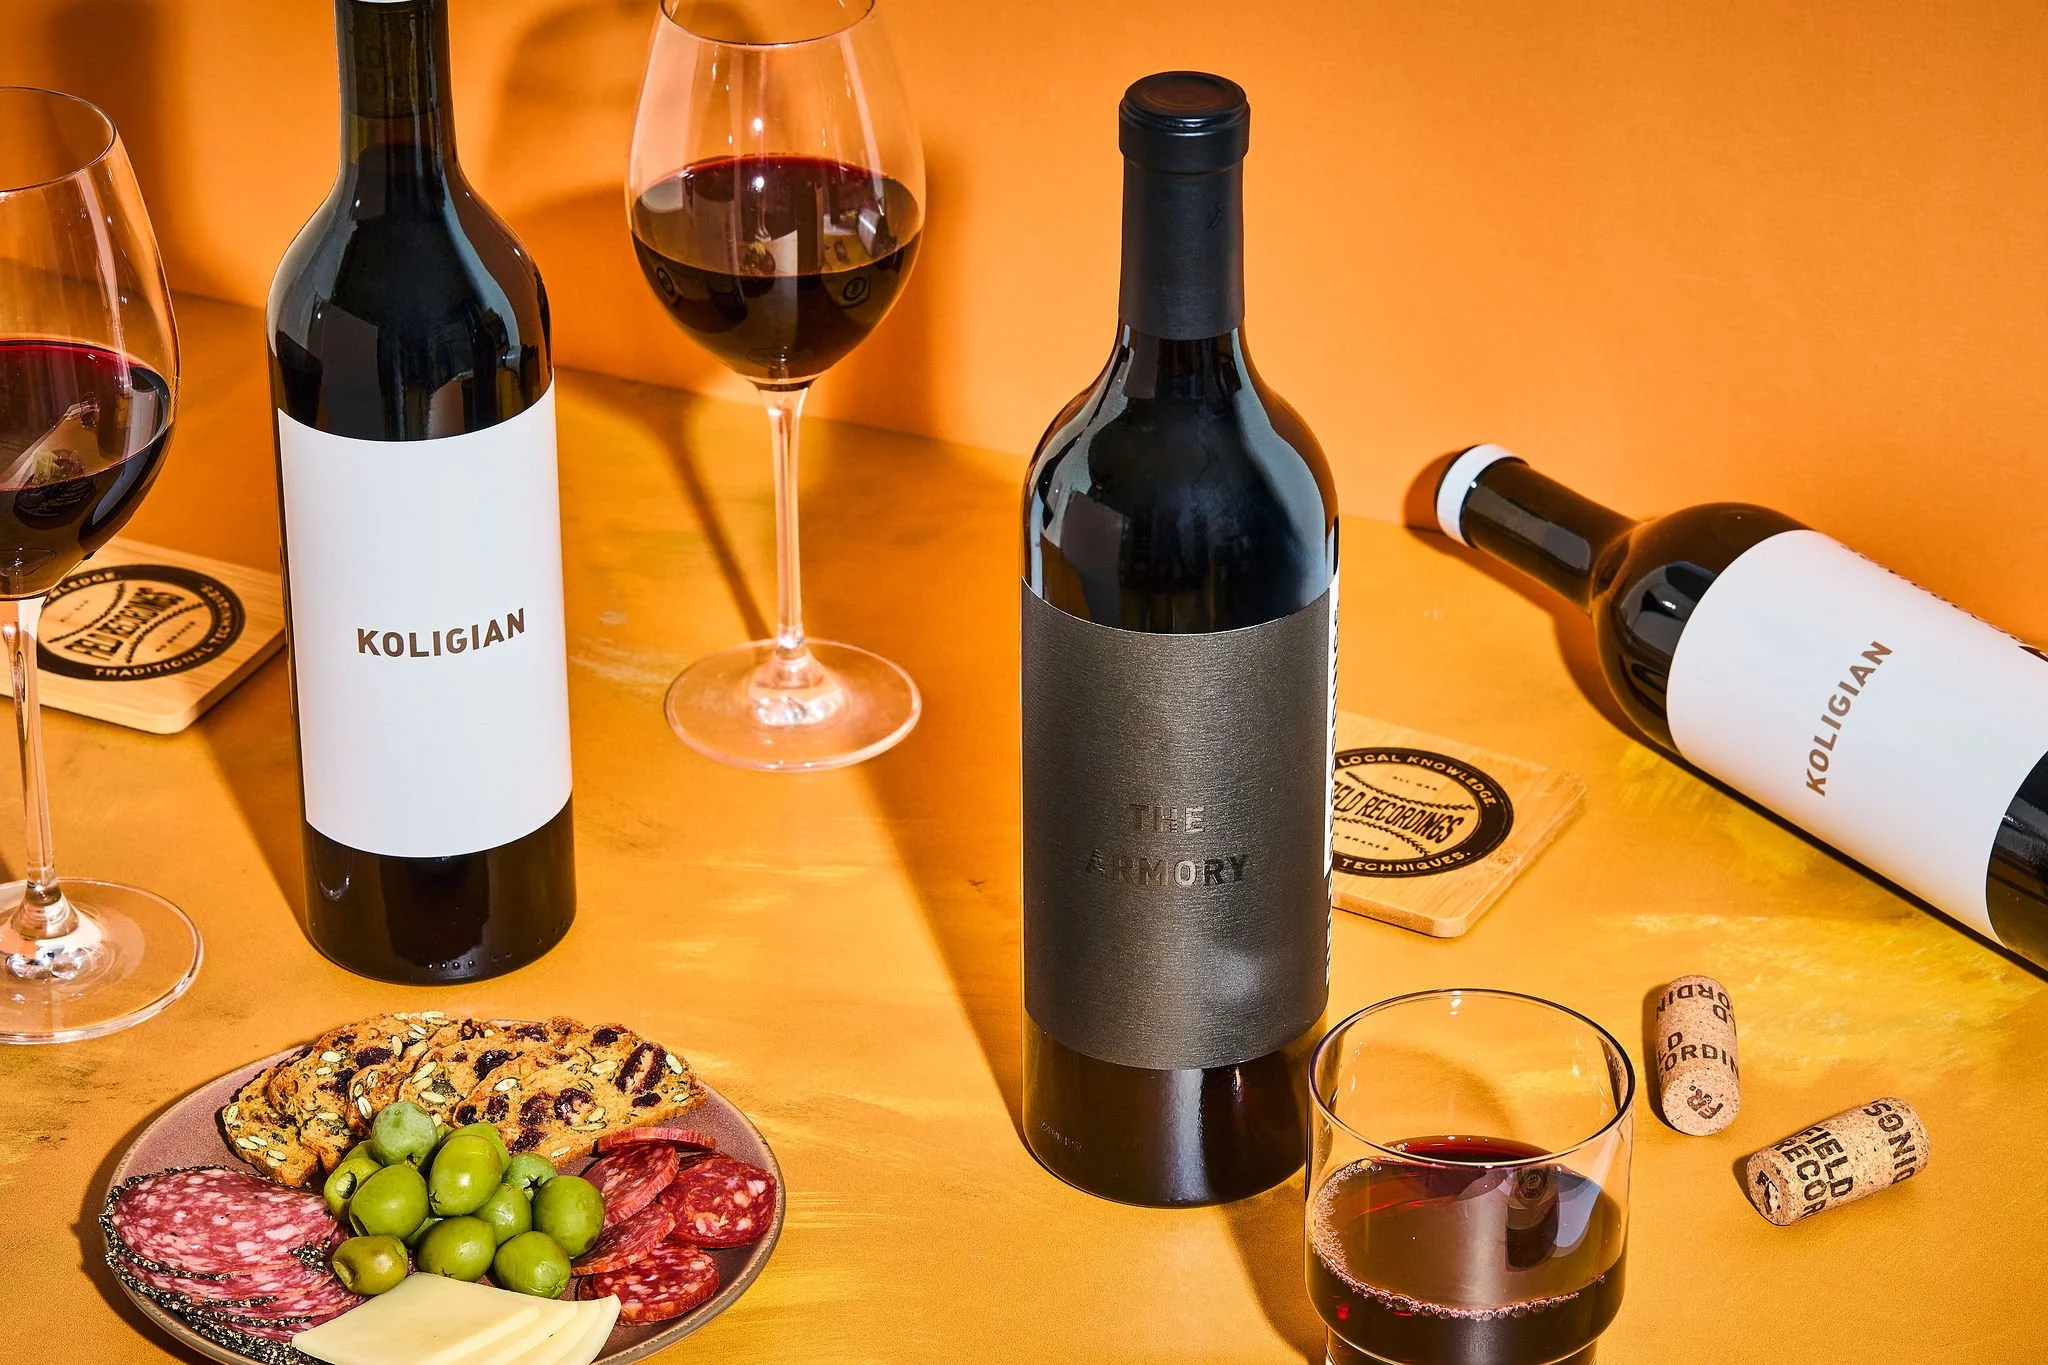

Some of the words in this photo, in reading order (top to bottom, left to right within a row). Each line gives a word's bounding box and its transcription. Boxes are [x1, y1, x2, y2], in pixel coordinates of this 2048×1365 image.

[357, 607, 525, 658] KOLIGIAN
[93, 646, 213, 677] TRADITIONAL
[1806, 641, 1893, 796] KOLIGIAN
[1338, 753, 1401, 768] LOCAL
[1128, 803, 1206, 833] THE
[1358, 796, 1464, 843] RECORDINGS
[1086, 849, 1250, 887] ARMORY
[1800, 1126, 1854, 1198] FIELD
